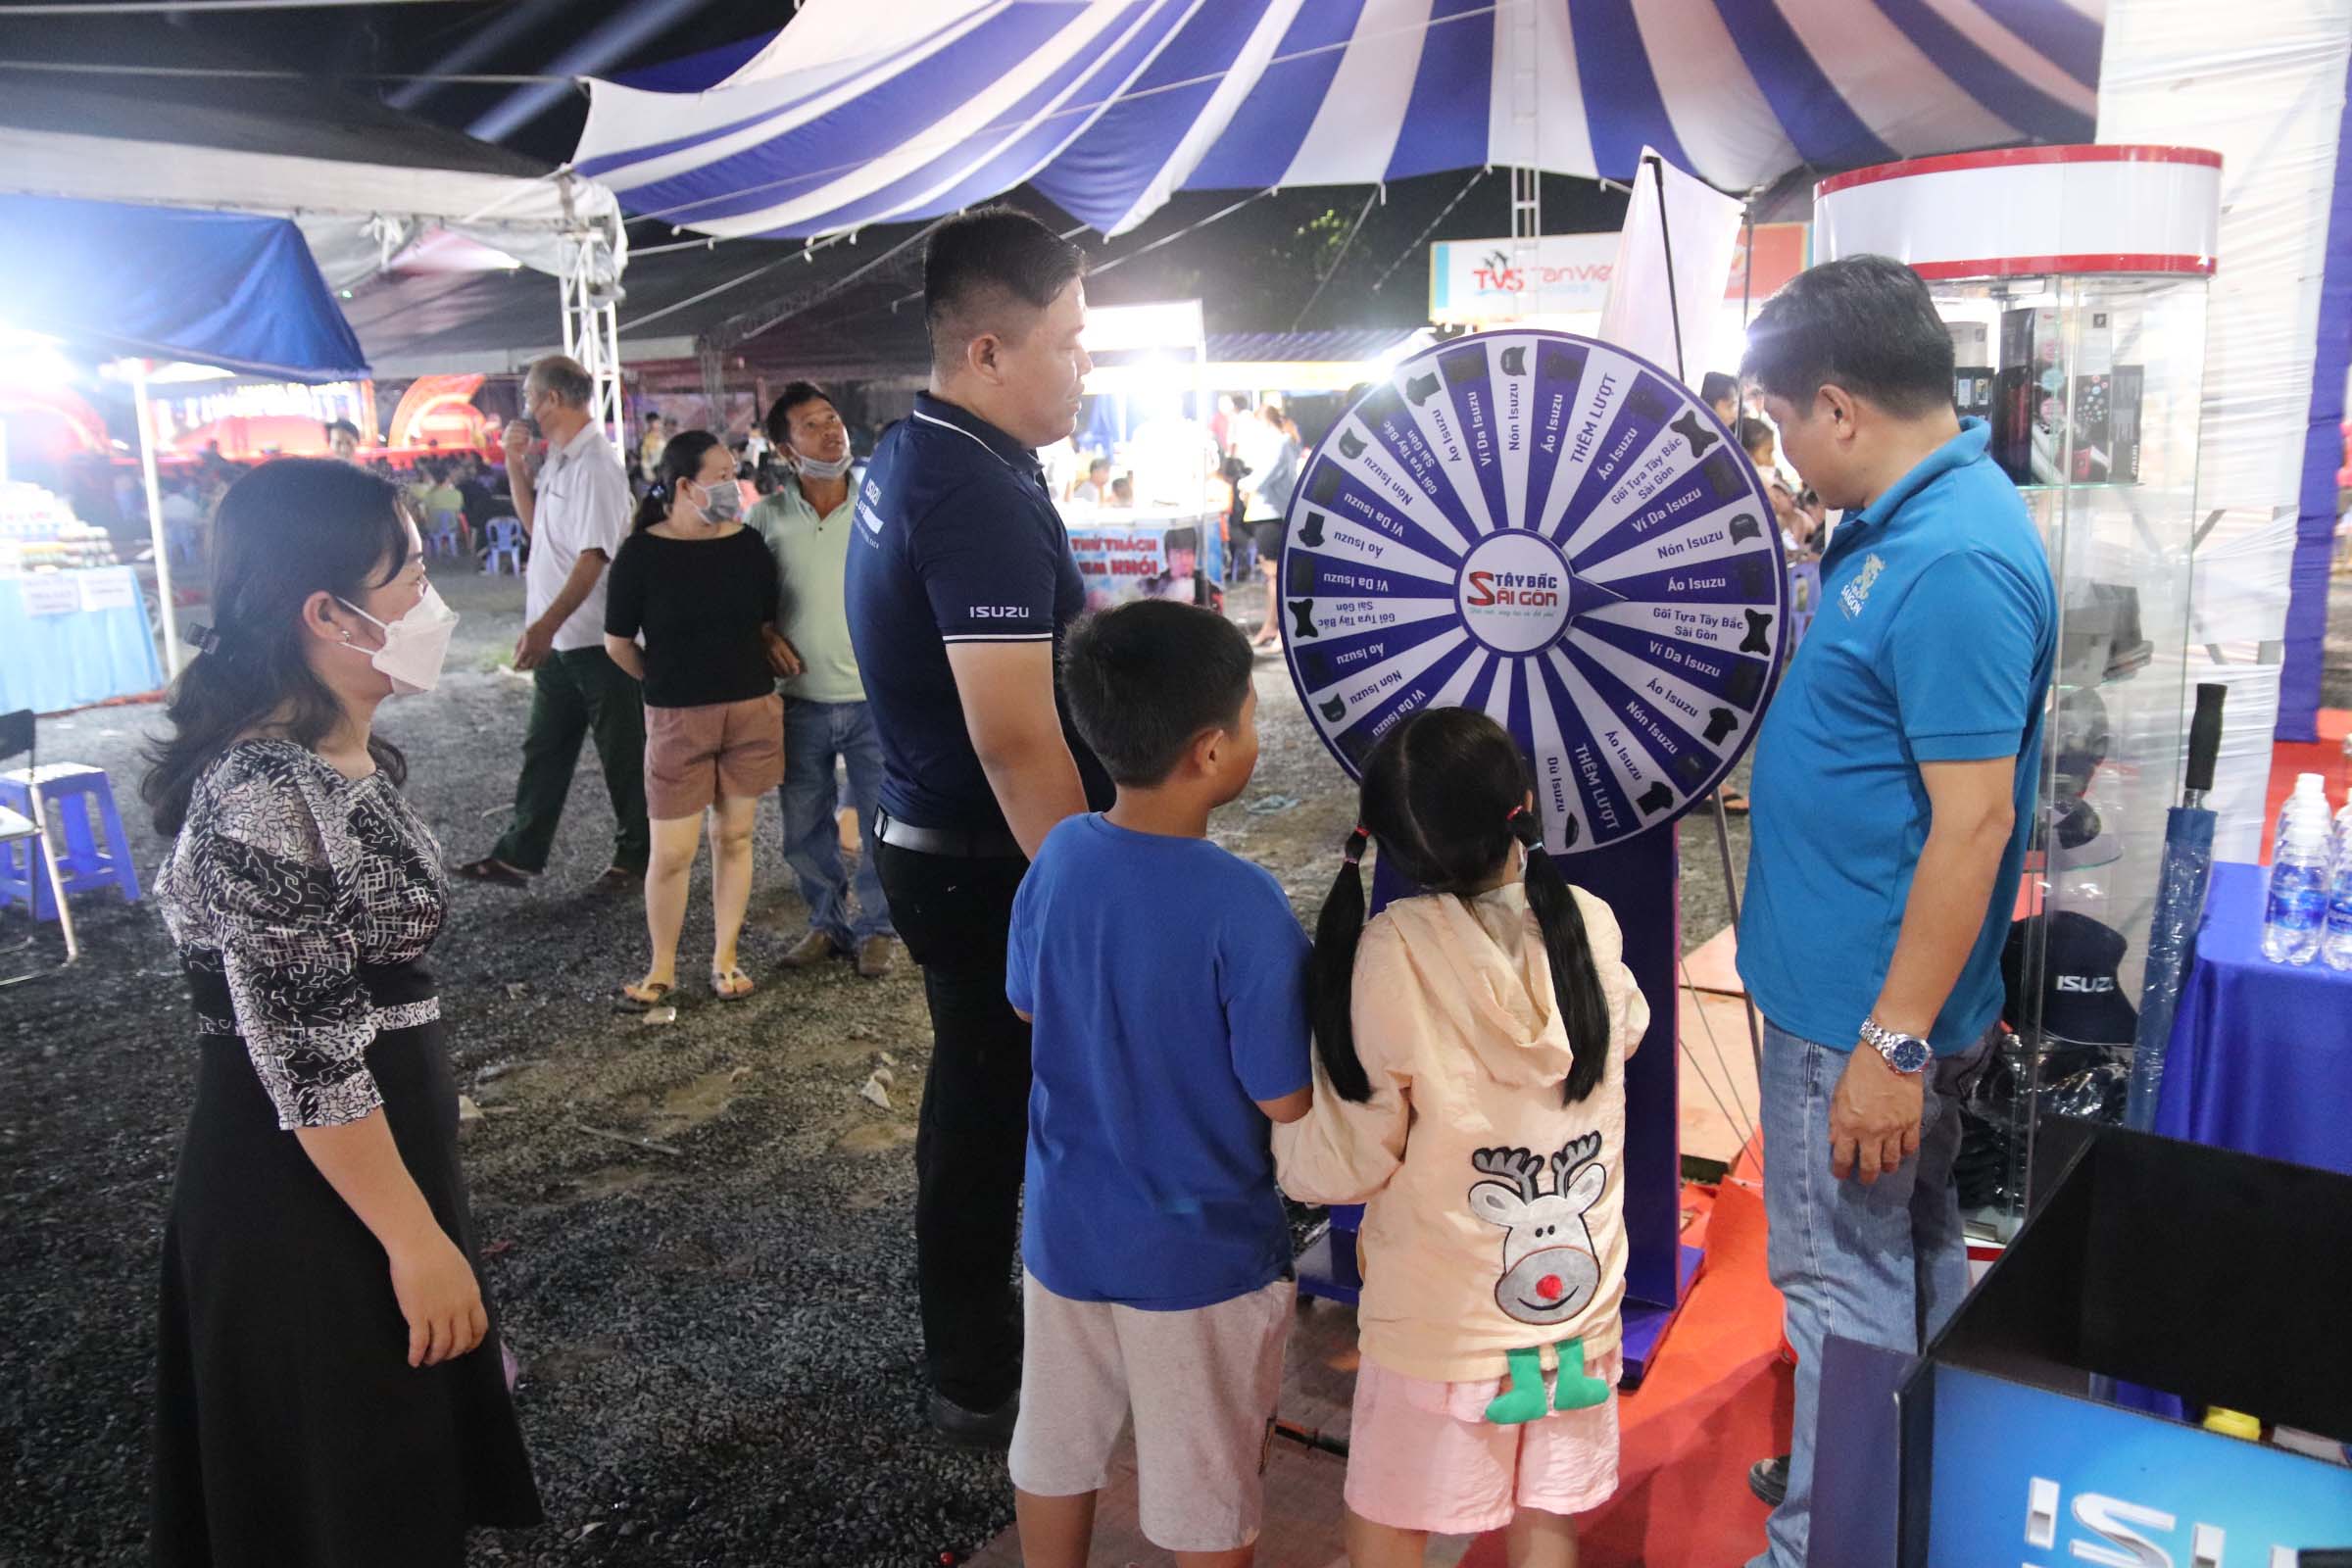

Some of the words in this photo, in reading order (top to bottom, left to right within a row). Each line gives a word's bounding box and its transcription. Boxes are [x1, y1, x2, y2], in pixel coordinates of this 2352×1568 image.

[1474, 270, 1524, 291] TVS
[1468, 391, 1484, 428] Isuzu
[1508, 383, 1519, 419] Isuzu
[1545, 394, 1563, 431] Isuzu
[1570, 419, 1598, 464] THÊM
[1590, 372, 1617, 420] LƯỢT
[1433, 409, 1453, 444] Isuzu
[1477, 431, 1488, 449] Da
[1508, 424, 1519, 451] Nón
[1541, 435, 1556, 453] Áo
[1448, 445, 1462, 463] Áo
[1479, 452, 1492, 466] Ví
[1596, 461, 1614, 481] Áo
[1612, 427, 1639, 463] Isuzu
[1364, 457, 1393, 486] Isuzu
[1392, 481, 1413, 506] Nón
[1344, 493, 1375, 518] Isuzu
[1632, 514, 1647, 533] Ví
[1649, 507, 1666, 524] Da
[1666, 487, 1702, 514] Isuzu
[1375, 512, 1392, 528] Da
[1334, 531, 1365, 551] Isuzu
[1390, 524, 1404, 538] Ví
[1368, 543, 1384, 559] Áo
[1657, 544, 1685, 559] Nón
[1687, 530, 1724, 549] Isuzu
[1324, 572, 1355, 588] Isuzu
[1358, 577, 1373, 590] Da
[1377, 580, 1389, 592] Ví
[1495, 572, 1525, 587] TÂY
[1527, 573, 1557, 589] BẮC
[1668, 576, 1685, 592] Áo
[1689, 577, 1726, 590] Isuzu
[969, 607, 1029, 618] ISUZU
[1336, 648, 1368, 665] Isuzu
[1369, 642, 1385, 658] Áo
[1649, 640, 1662, 656] Ví
[1666, 647, 1683, 663] Da
[1685, 655, 1721, 677] Isuzu
[1398, 698, 1414, 713] Da
[1411, 689, 1426, 703] Ví
[1646, 677, 1664, 695] Áo
[1666, 690, 1699, 718] Isuzu
[1372, 710, 1400, 737] Isuzu
[1626, 701, 1649, 724] Nón
[1647, 723, 1679, 755] Isuzu
[1546, 757, 1559, 774] Dù
[1605, 730, 1619, 748] Áo
[1617, 747, 1642, 781] Isuzu
[1551, 777, 1566, 812] Isuzu
[1575, 743, 1601, 787] THÊM
[1592, 788, 1621, 829] LƯỢT
[2056, 975, 2115, 993] ISUZ
